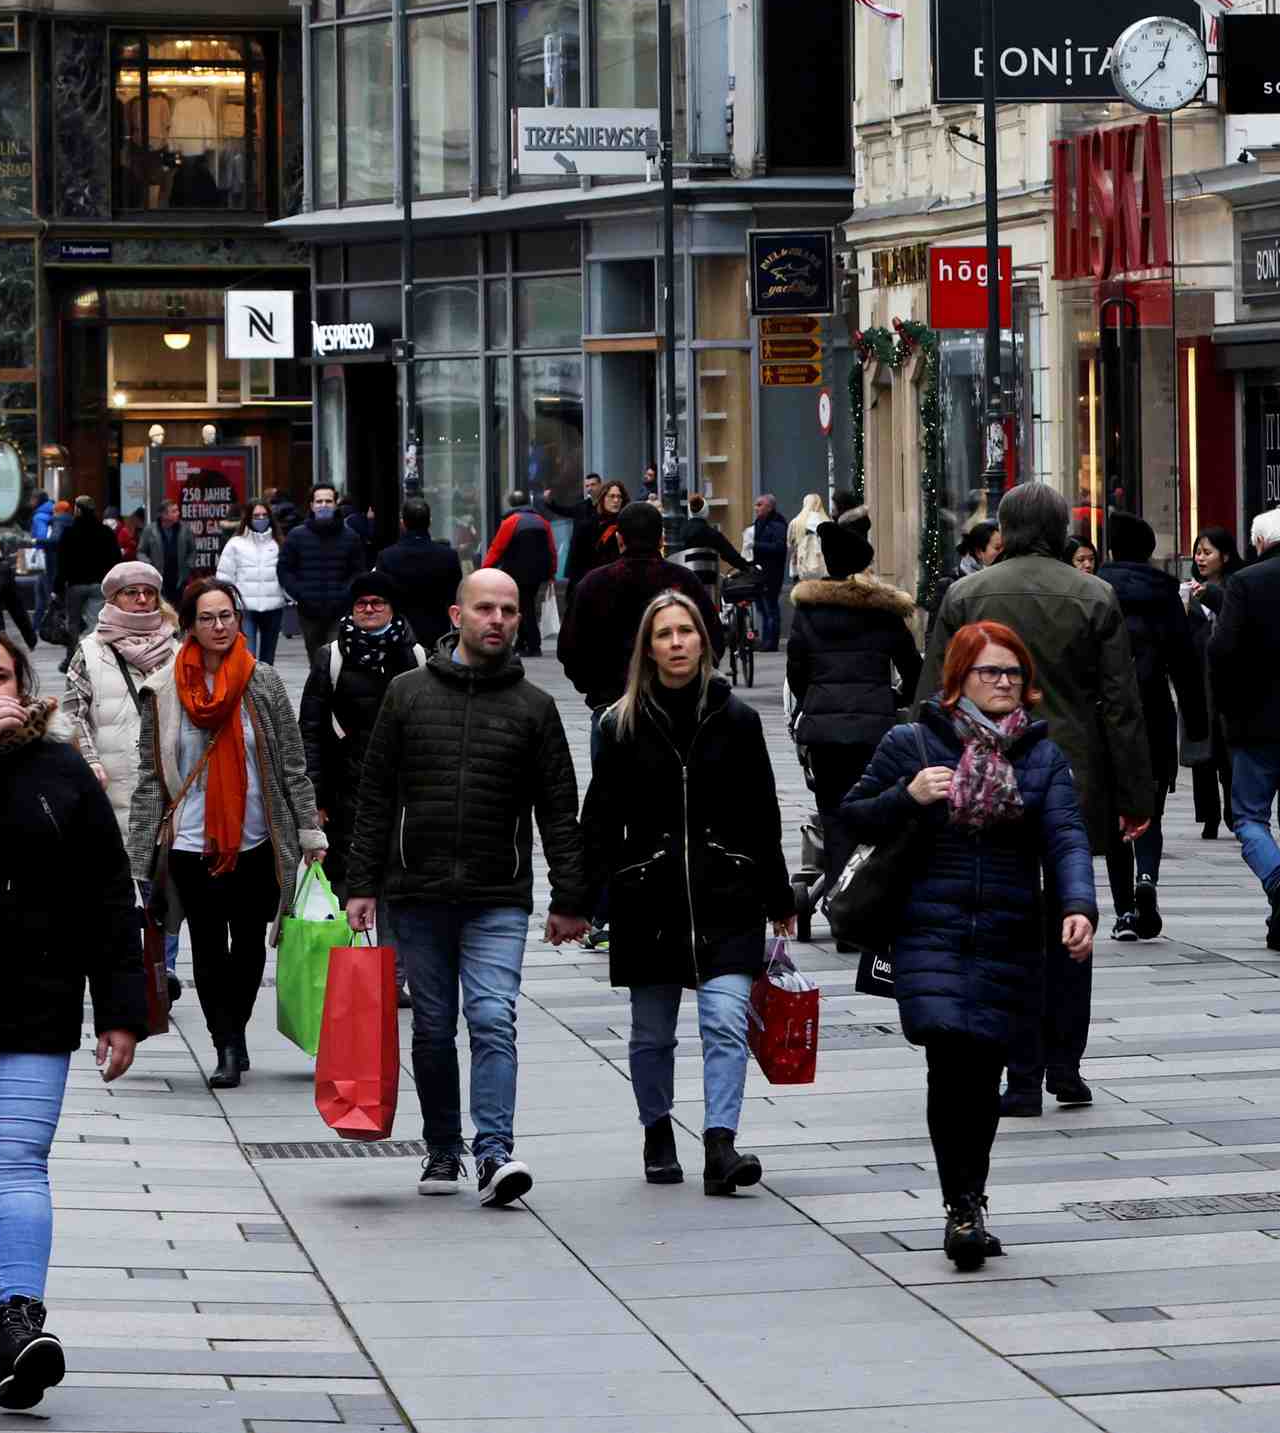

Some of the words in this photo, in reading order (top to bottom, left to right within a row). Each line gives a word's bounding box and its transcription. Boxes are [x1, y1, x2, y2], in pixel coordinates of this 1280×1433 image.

[524, 124, 650, 147] TRZEŚNIEWSK
[1049, 115, 1172, 281] LISKA
[311, 320, 375, 356] NESPRESSO
[1265, 413, 1275, 450] IT
[182, 488, 201, 501] 250
[204, 487, 233, 502] JAHRE
